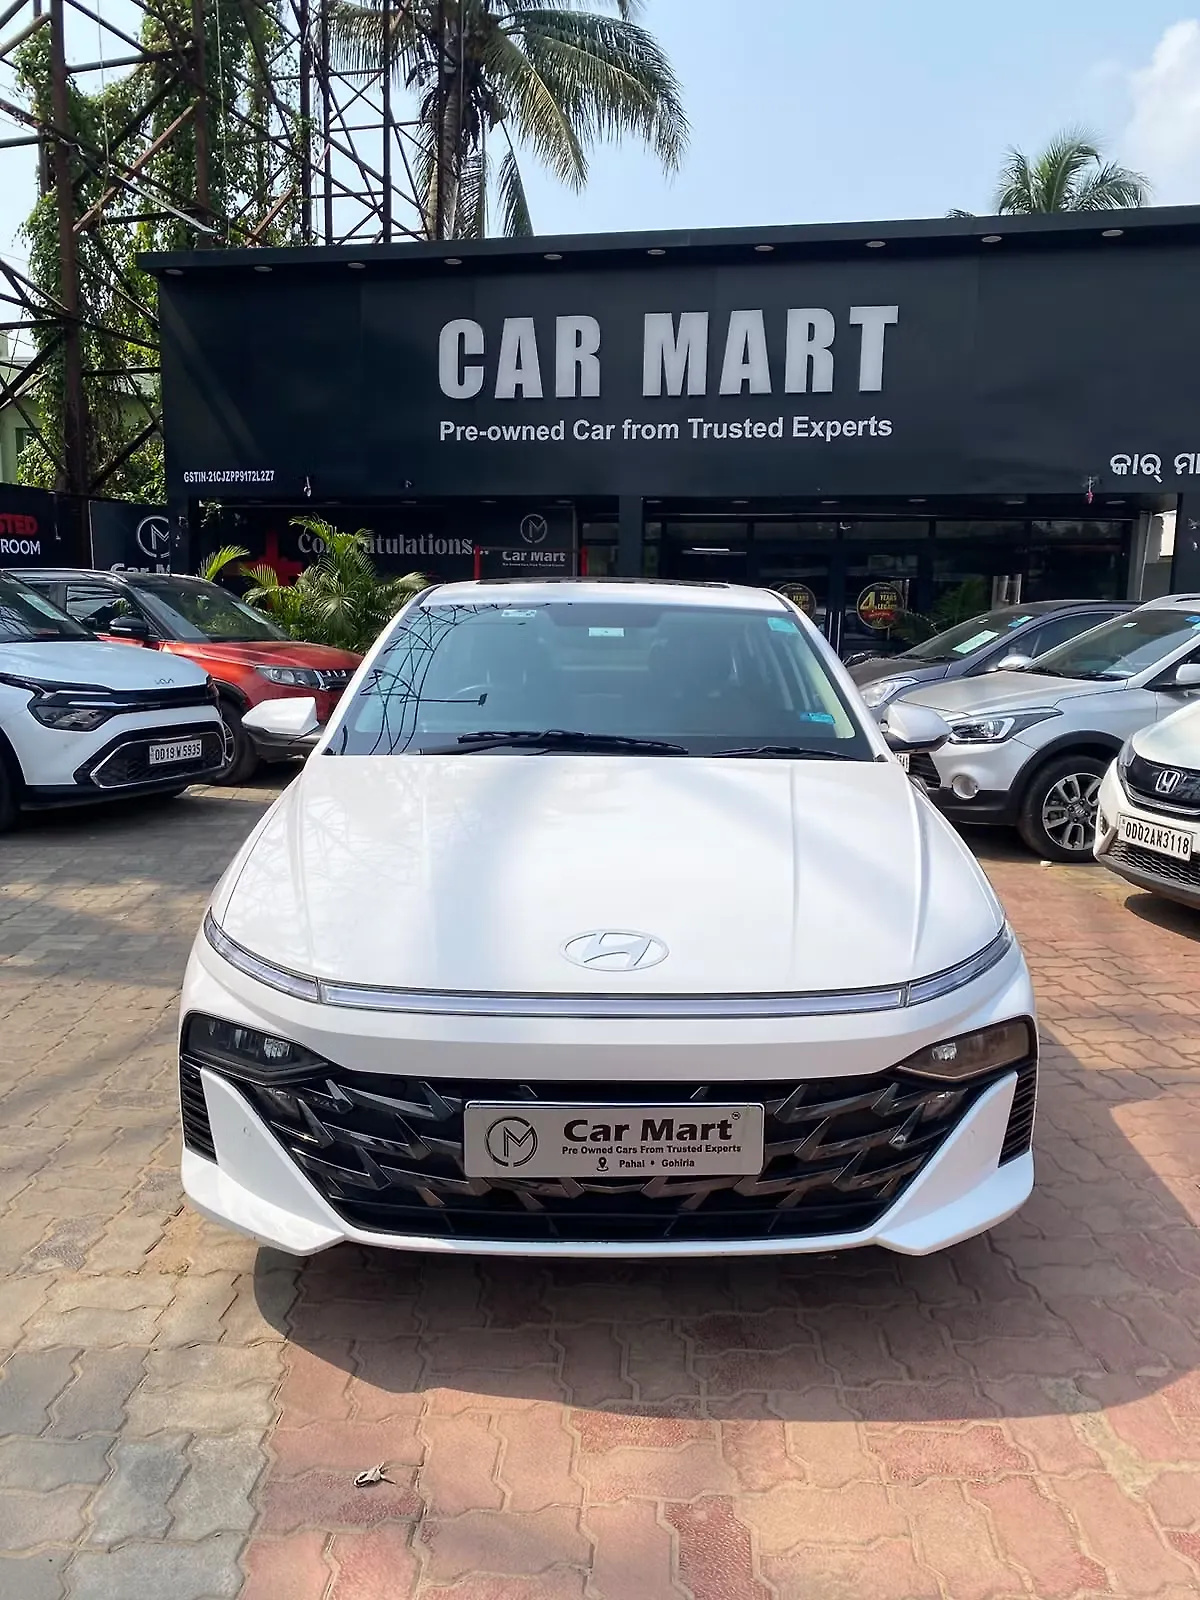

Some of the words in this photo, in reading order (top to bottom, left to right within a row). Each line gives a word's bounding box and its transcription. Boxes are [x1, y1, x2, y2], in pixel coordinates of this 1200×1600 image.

[439, 315, 602, 398] CAR
[642, 305, 898, 396] MART
[440, 420, 565, 441] Pre-owned
[573, 419, 615, 440] Car
[622, 418, 680, 440] from
[687, 417, 784, 439] Trusted
[792, 415, 893, 442] Experts
[563, 1119, 630, 1142] Car
[640, 1118, 733, 1141] Mart
[562, 1146, 578, 1155] Pre
[580, 1146, 613, 1154] Owned
[616, 1145, 638, 1154] Cars
[640, 1145, 664, 1154] From
[667, 1145, 702, 1153] Trusted
[705, 1144, 741, 1155] Experts
[619, 1159, 645, 1168] Pahal
